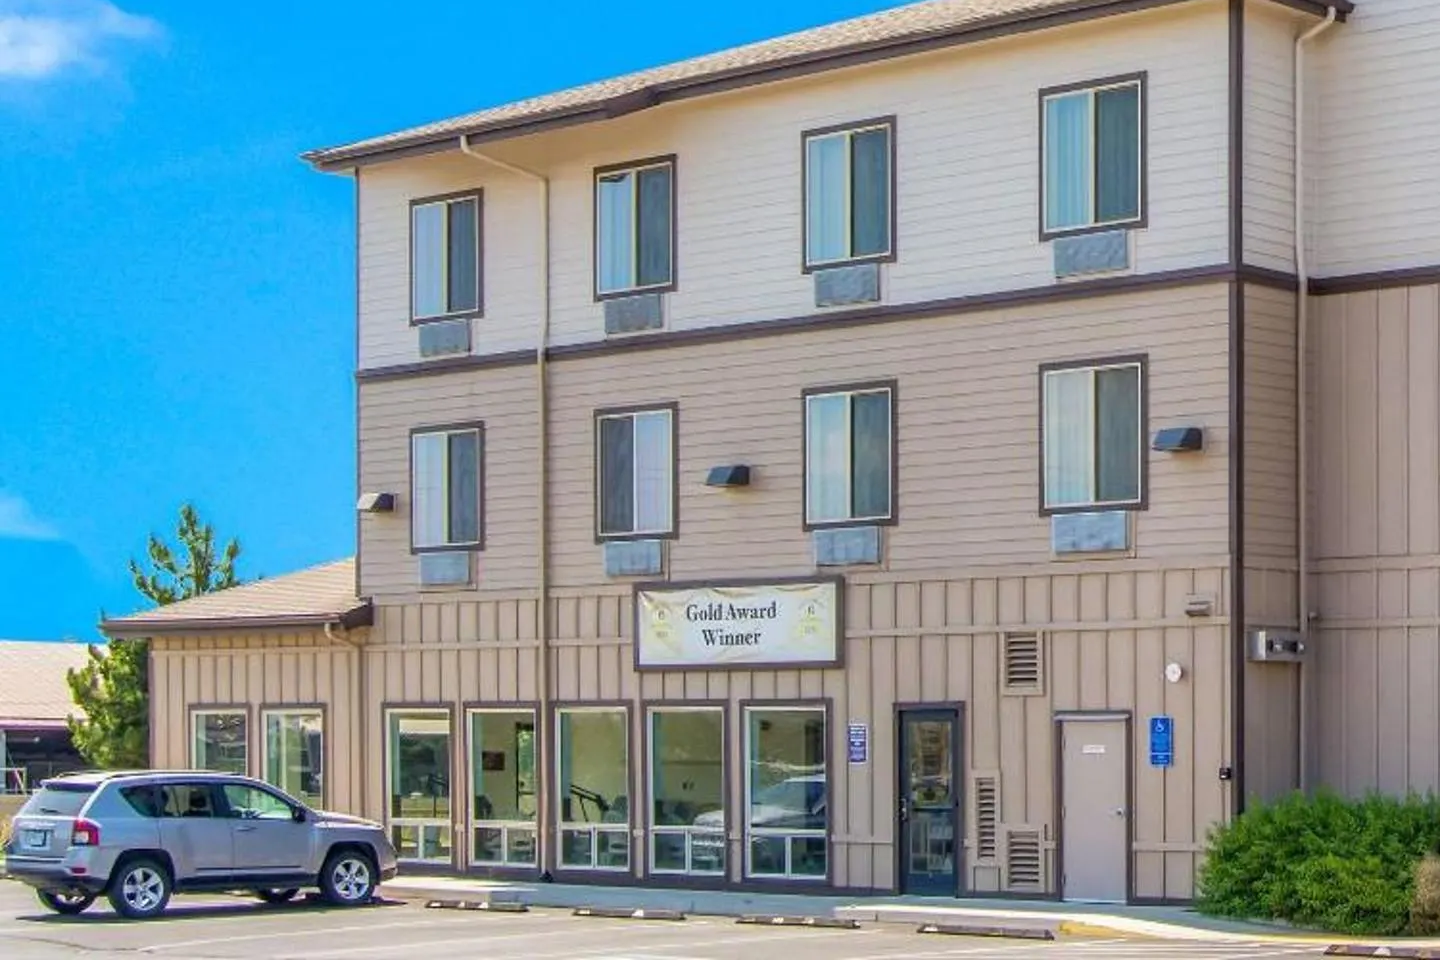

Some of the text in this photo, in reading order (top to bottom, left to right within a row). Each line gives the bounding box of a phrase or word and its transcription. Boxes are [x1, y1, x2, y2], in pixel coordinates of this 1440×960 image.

[686, 603, 723, 621] Gold
[726, 600, 777, 620] Award
[702, 628, 761, 646] Winner
